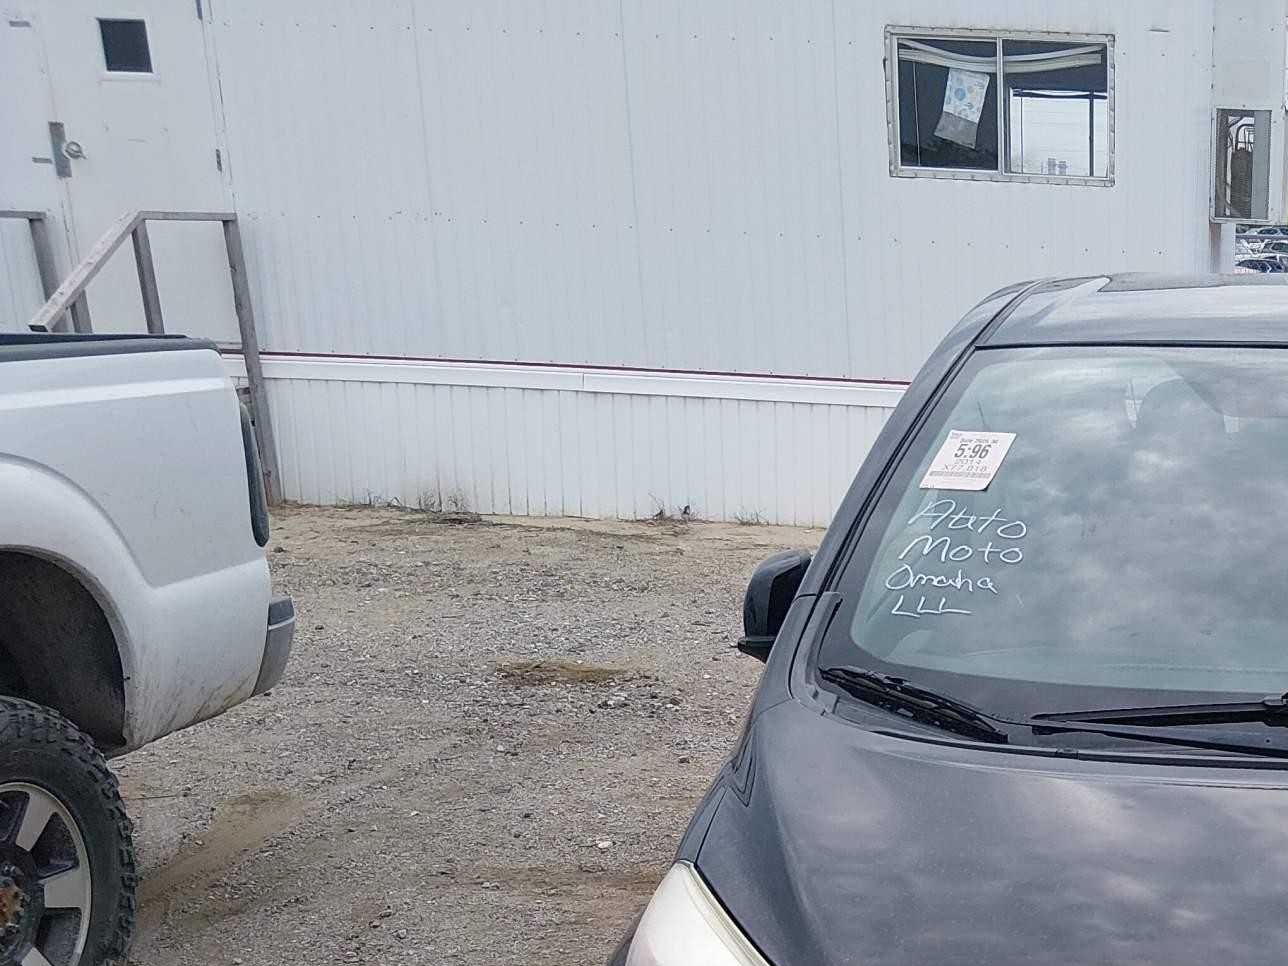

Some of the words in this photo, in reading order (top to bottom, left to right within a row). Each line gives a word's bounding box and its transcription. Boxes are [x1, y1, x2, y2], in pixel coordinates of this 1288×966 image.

[954, 444, 991, 458] 5:96
[898, 535, 1024, 563] Moto
[885, 564, 999, 594] Omaha
